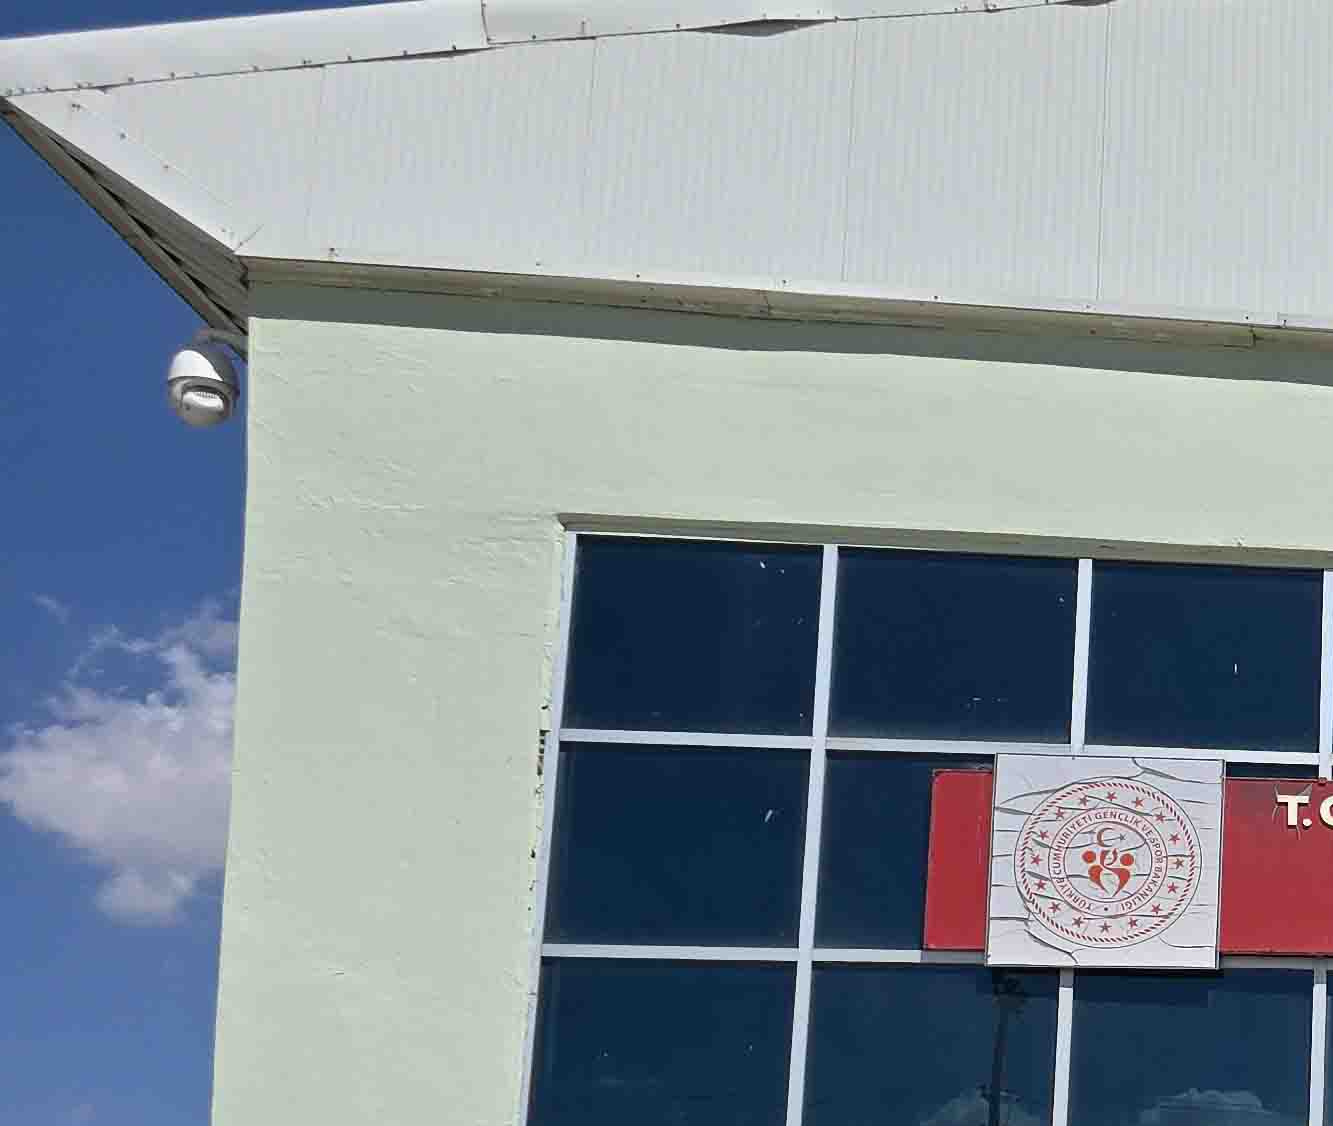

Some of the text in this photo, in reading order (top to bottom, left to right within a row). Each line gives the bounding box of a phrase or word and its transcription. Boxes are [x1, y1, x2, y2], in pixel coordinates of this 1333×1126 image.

[1095, 811, 1141, 828] GENÇLİK
[1141, 823, 1154, 838] VE
[1052, 815, 1093, 876] CUMHURİYETİ
[1150, 837, 1163, 863] SPOR
[1121, 866, 1163, 911] BAKANLIĞI
